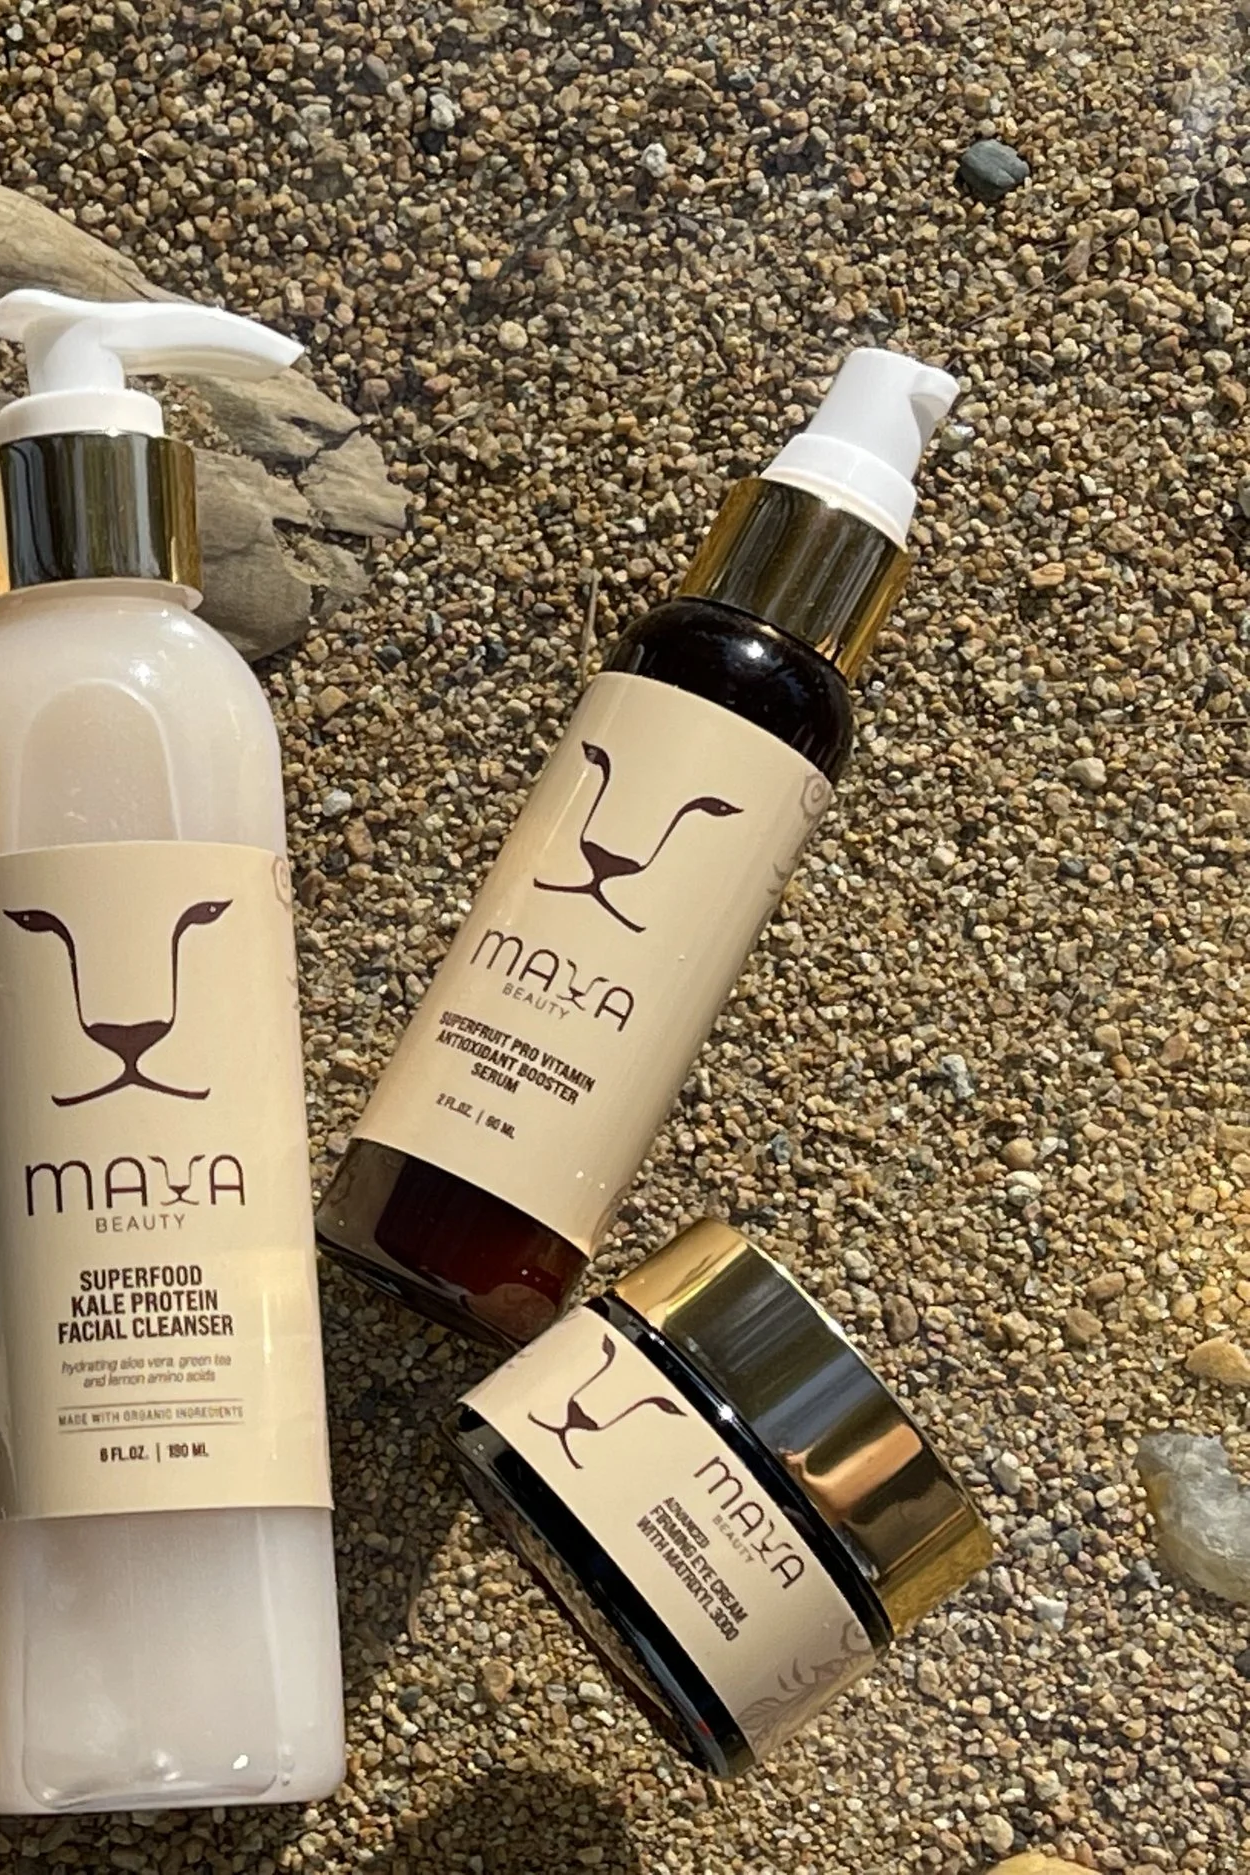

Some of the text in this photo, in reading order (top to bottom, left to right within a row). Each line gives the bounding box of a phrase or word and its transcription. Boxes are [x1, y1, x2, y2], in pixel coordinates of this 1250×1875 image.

[502, 982, 570, 1020] BEAUTY
[435, 1029, 580, 1105] ANTIOXIDANT BOOSTER
[439, 1011, 596, 1094] SUPERFRUIT PRO VITAMIN
[470, 1062, 521, 1094] SERUM
[501, 1121, 516, 1140] ML
[95, 1214, 186, 1234] BEAUTY
[79, 1264, 203, 1292] SUPERFOOD
[70, 1289, 219, 1318] KALE PROTEIN
[58, 1314, 234, 1345] FACIAL CLEANSER
[61, 1356, 117, 1375] hydrating
[120, 1356, 144, 1370] aloe
[178, 1356, 212, 1370] green
[214, 1353, 232, 1367] tea
[83, 1369, 216, 1389] and lemon amino acids
[58, 1405, 244, 1426] MADE WITH ORGANIC INGREDIENTS
[191, 1442, 209, 1458] ML
[662, 1497, 710, 1549] ADVANCED
[712, 1515, 755, 1563] BEAUTY
[636, 1516, 740, 1642] WITH MATRIXYL 3000
[650, 1505, 749, 1624] FIRMING EYE CREAM
